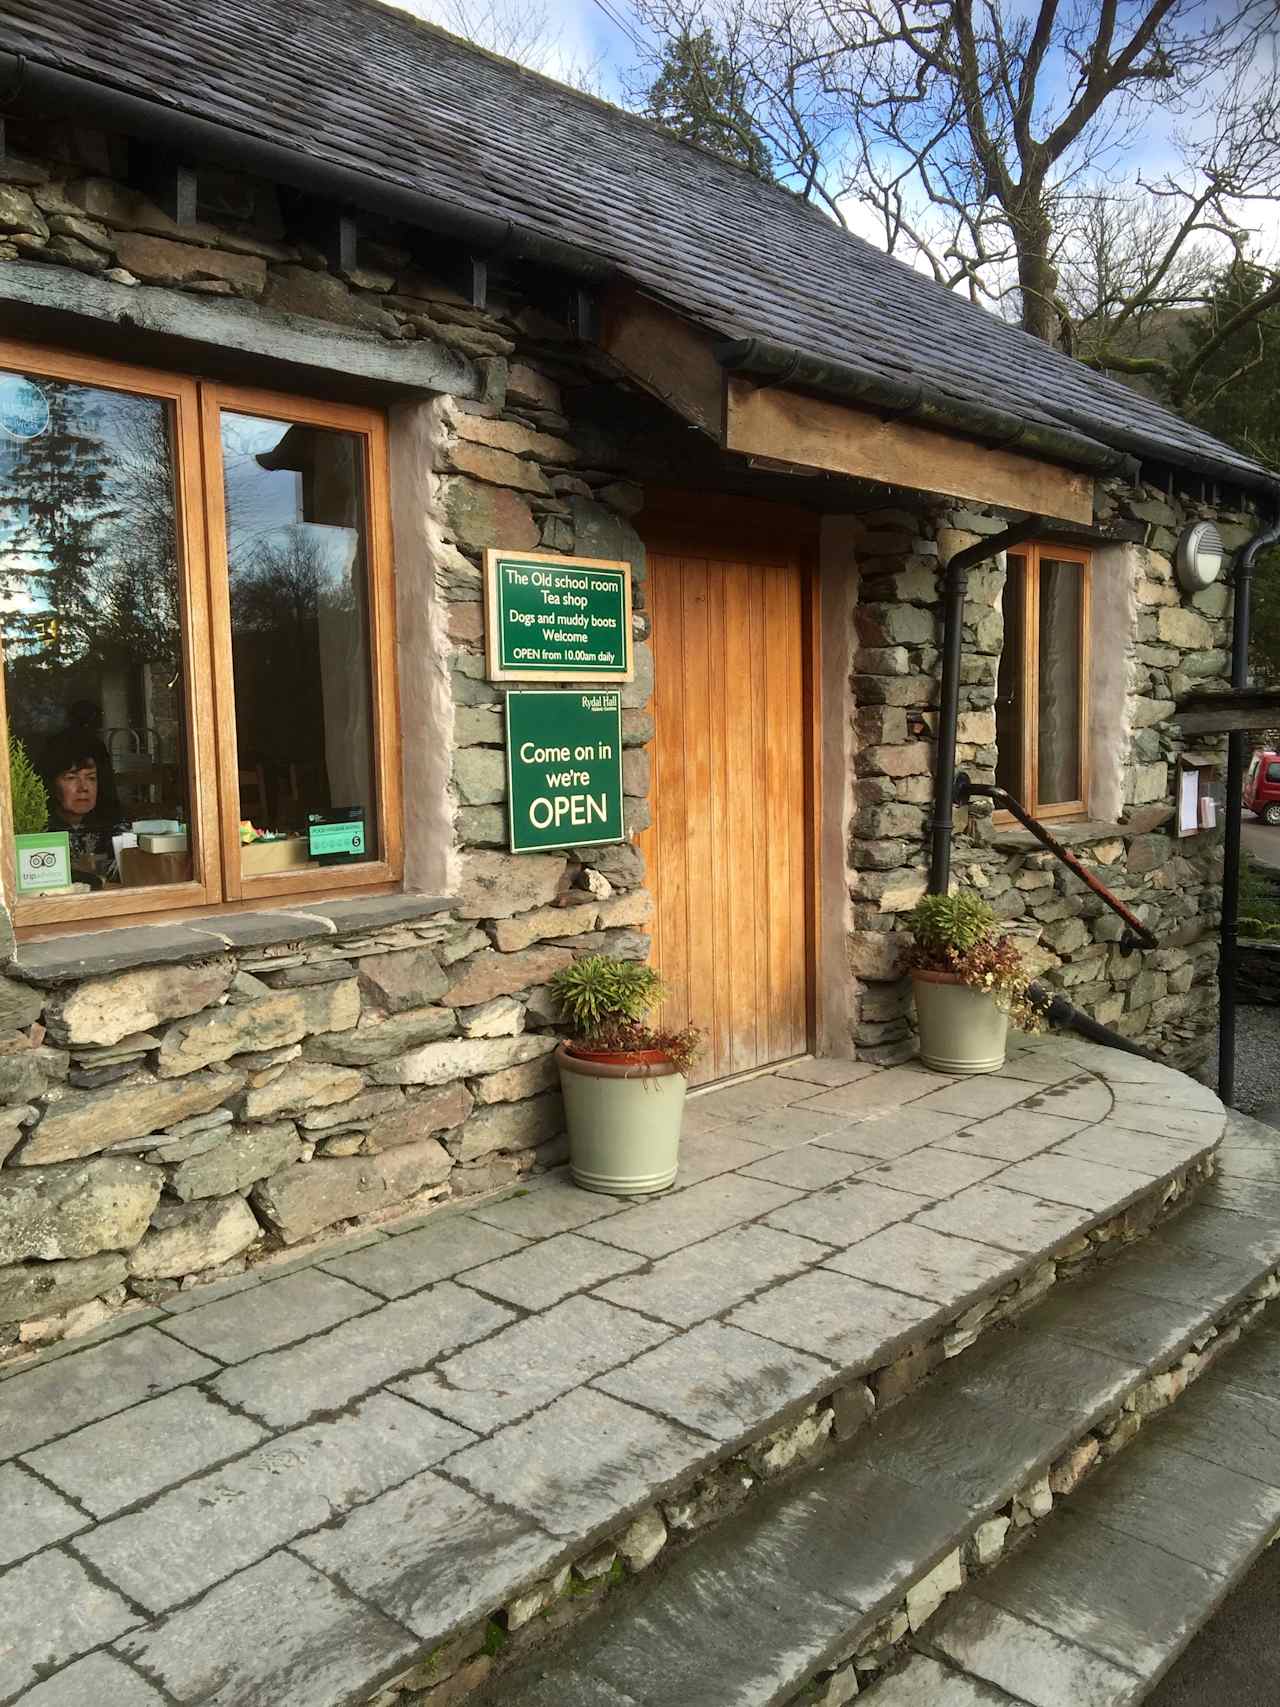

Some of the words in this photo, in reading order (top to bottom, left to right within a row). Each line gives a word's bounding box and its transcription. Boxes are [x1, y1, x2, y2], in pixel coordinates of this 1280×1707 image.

[505, 569, 528, 585] The
[531, 572, 552, 587] Old
[554, 575, 588, 590] school
[591, 580, 618, 592] room
[540, 590, 560, 605] Tea
[563, 592, 588, 610] shop
[509, 609, 536, 626] Dogs
[537, 612, 555, 625] and
[557, 614, 589, 629] muddy
[591, 615, 616, 628] boots
[542, 628, 588, 643] Welcome
[513, 648, 540, 660] OPEN
[542, 649, 562, 660] from
[564, 650, 596, 662] 10.00am
[598, 652, 615, 664] daily
[582, 696, 602, 709] Rydal
[603, 696, 617, 707] Hall
[520, 742, 570, 764] Come
[574, 746, 594, 761] on
[598, 741, 612, 760] in
[546, 769, 590, 788] we're
[529, 792, 608, 829] OPEN
[353, 837, 360, 846] 5
